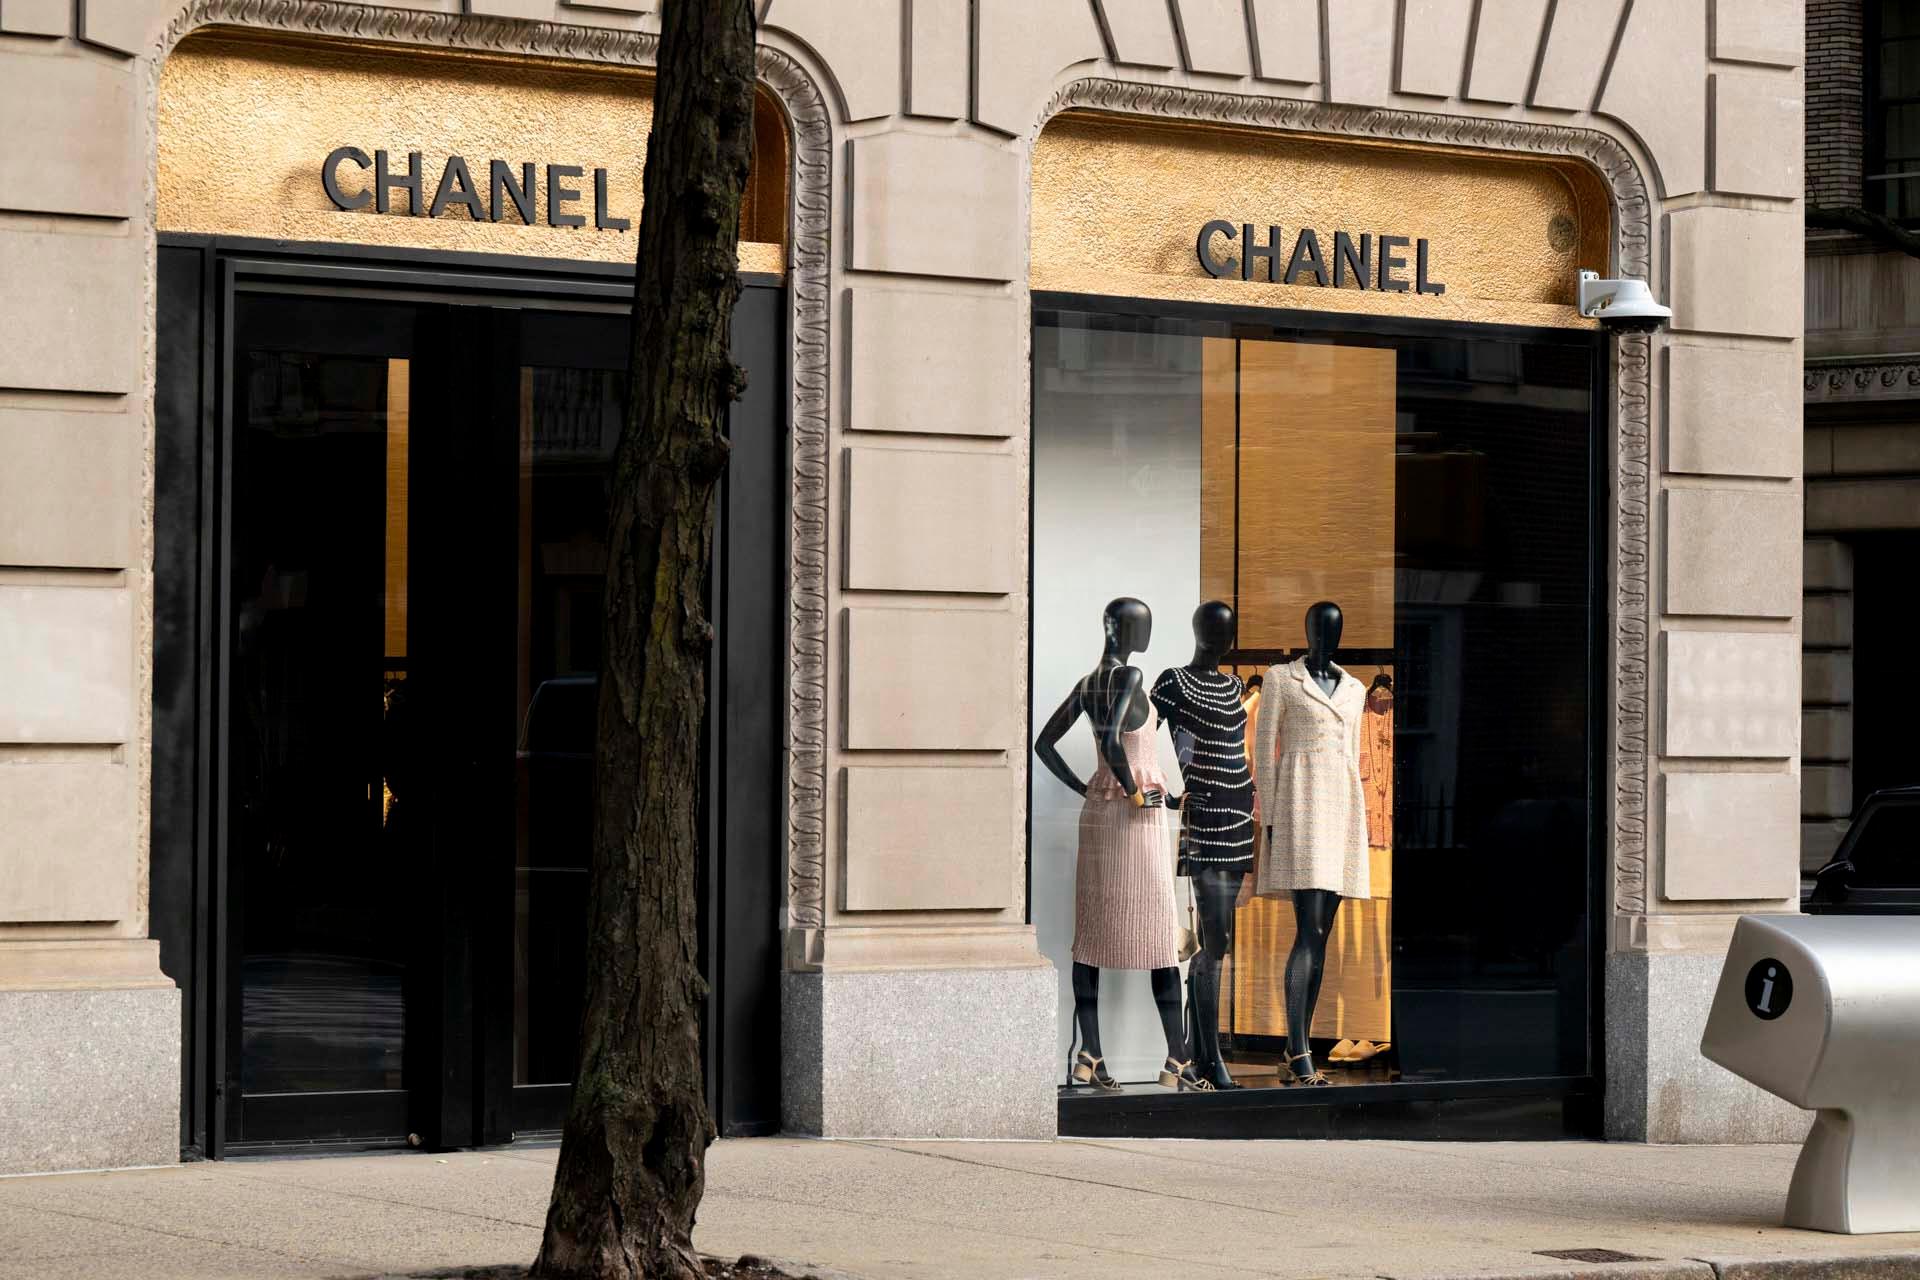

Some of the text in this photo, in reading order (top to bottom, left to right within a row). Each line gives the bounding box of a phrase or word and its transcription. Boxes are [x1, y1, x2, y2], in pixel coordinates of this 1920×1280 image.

[322, 146, 631, 232] CHANEL
[1197, 219, 1446, 295] CHANEL
[1757, 967, 1777, 1013] i
